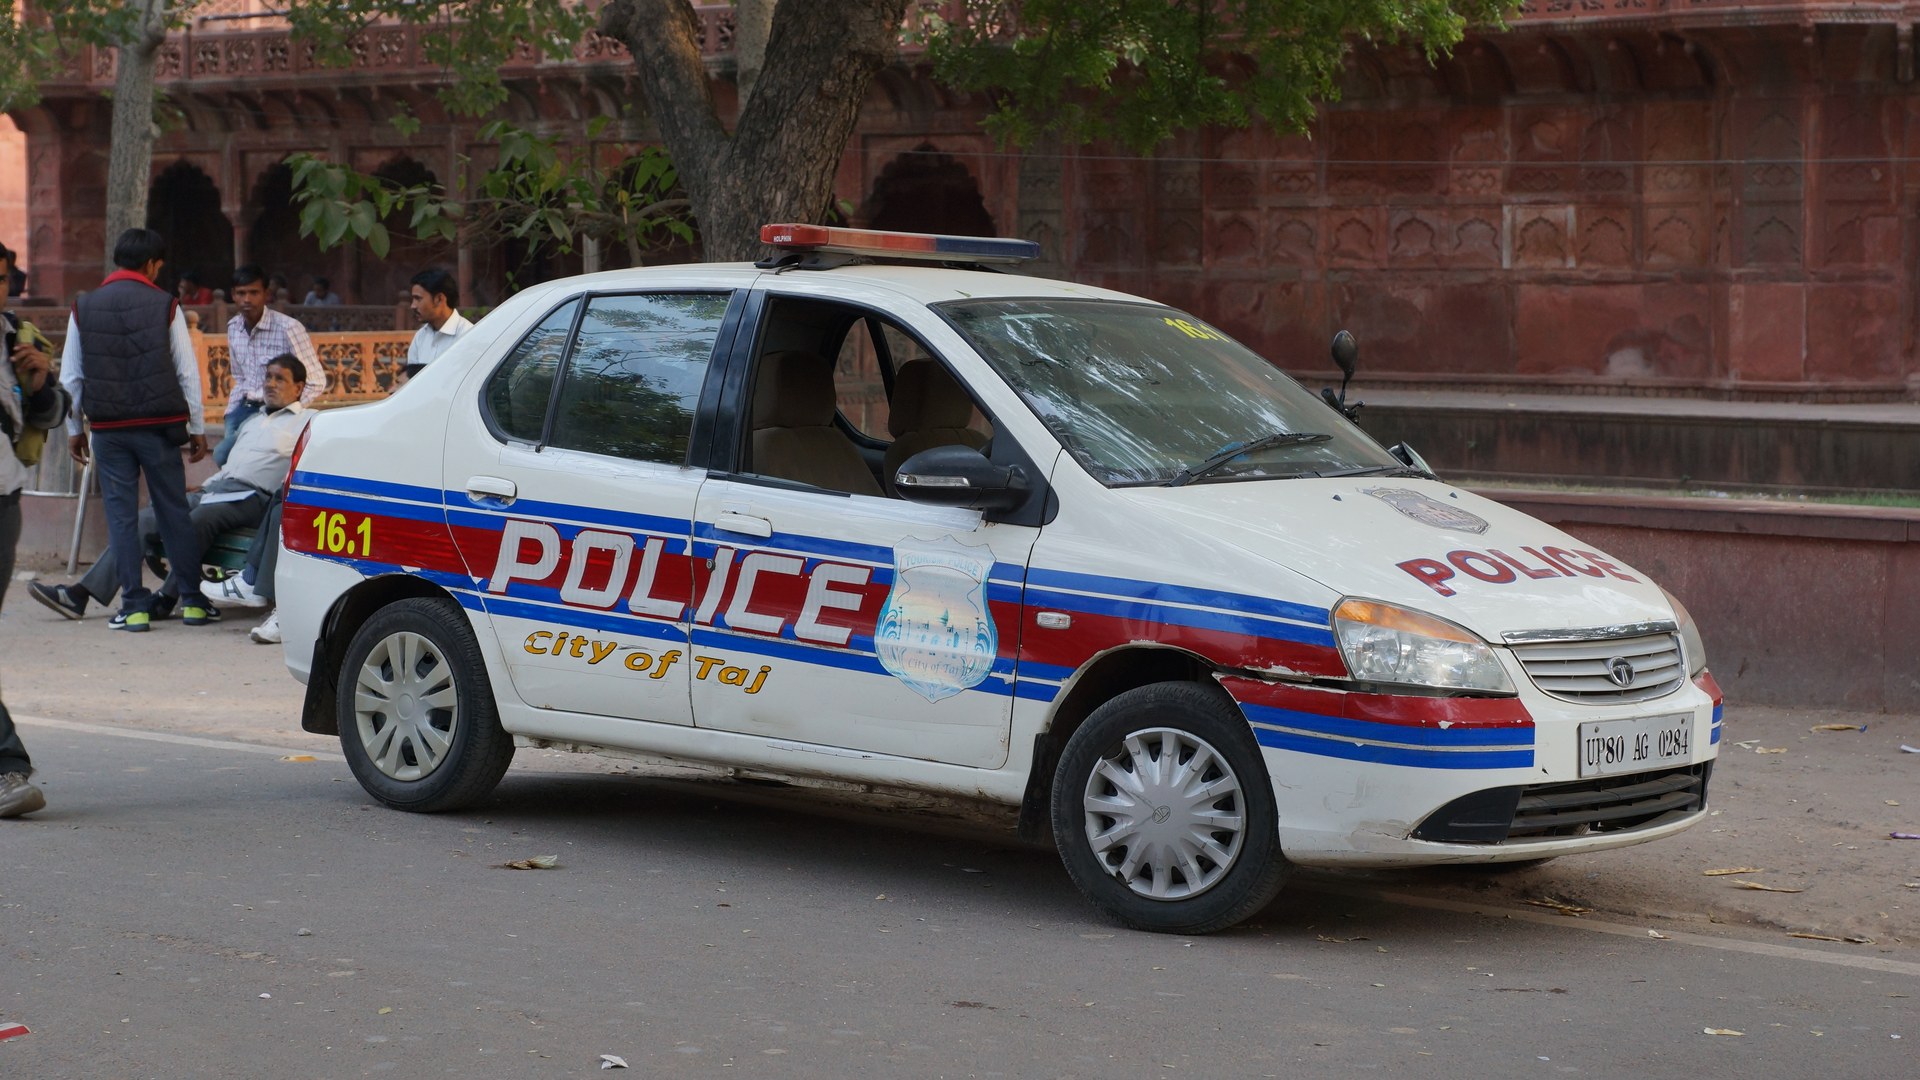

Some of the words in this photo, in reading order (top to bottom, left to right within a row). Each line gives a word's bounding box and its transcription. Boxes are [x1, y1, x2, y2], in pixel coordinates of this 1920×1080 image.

[312, 510, 371, 557] 16.1
[487, 518, 874, 647] POLICE
[1395, 546, 1642, 597] POLICE
[524, 630, 617, 664] City
[624, 650, 682, 679] of
[695, 656, 772, 694] Taj
[907, 657, 928, 672] City
[930, 661, 942, 673] of
[1586, 735, 1624, 766] UP80
[1632, 732, 1649, 761] AG
[1658, 728, 1688, 757] 0284
